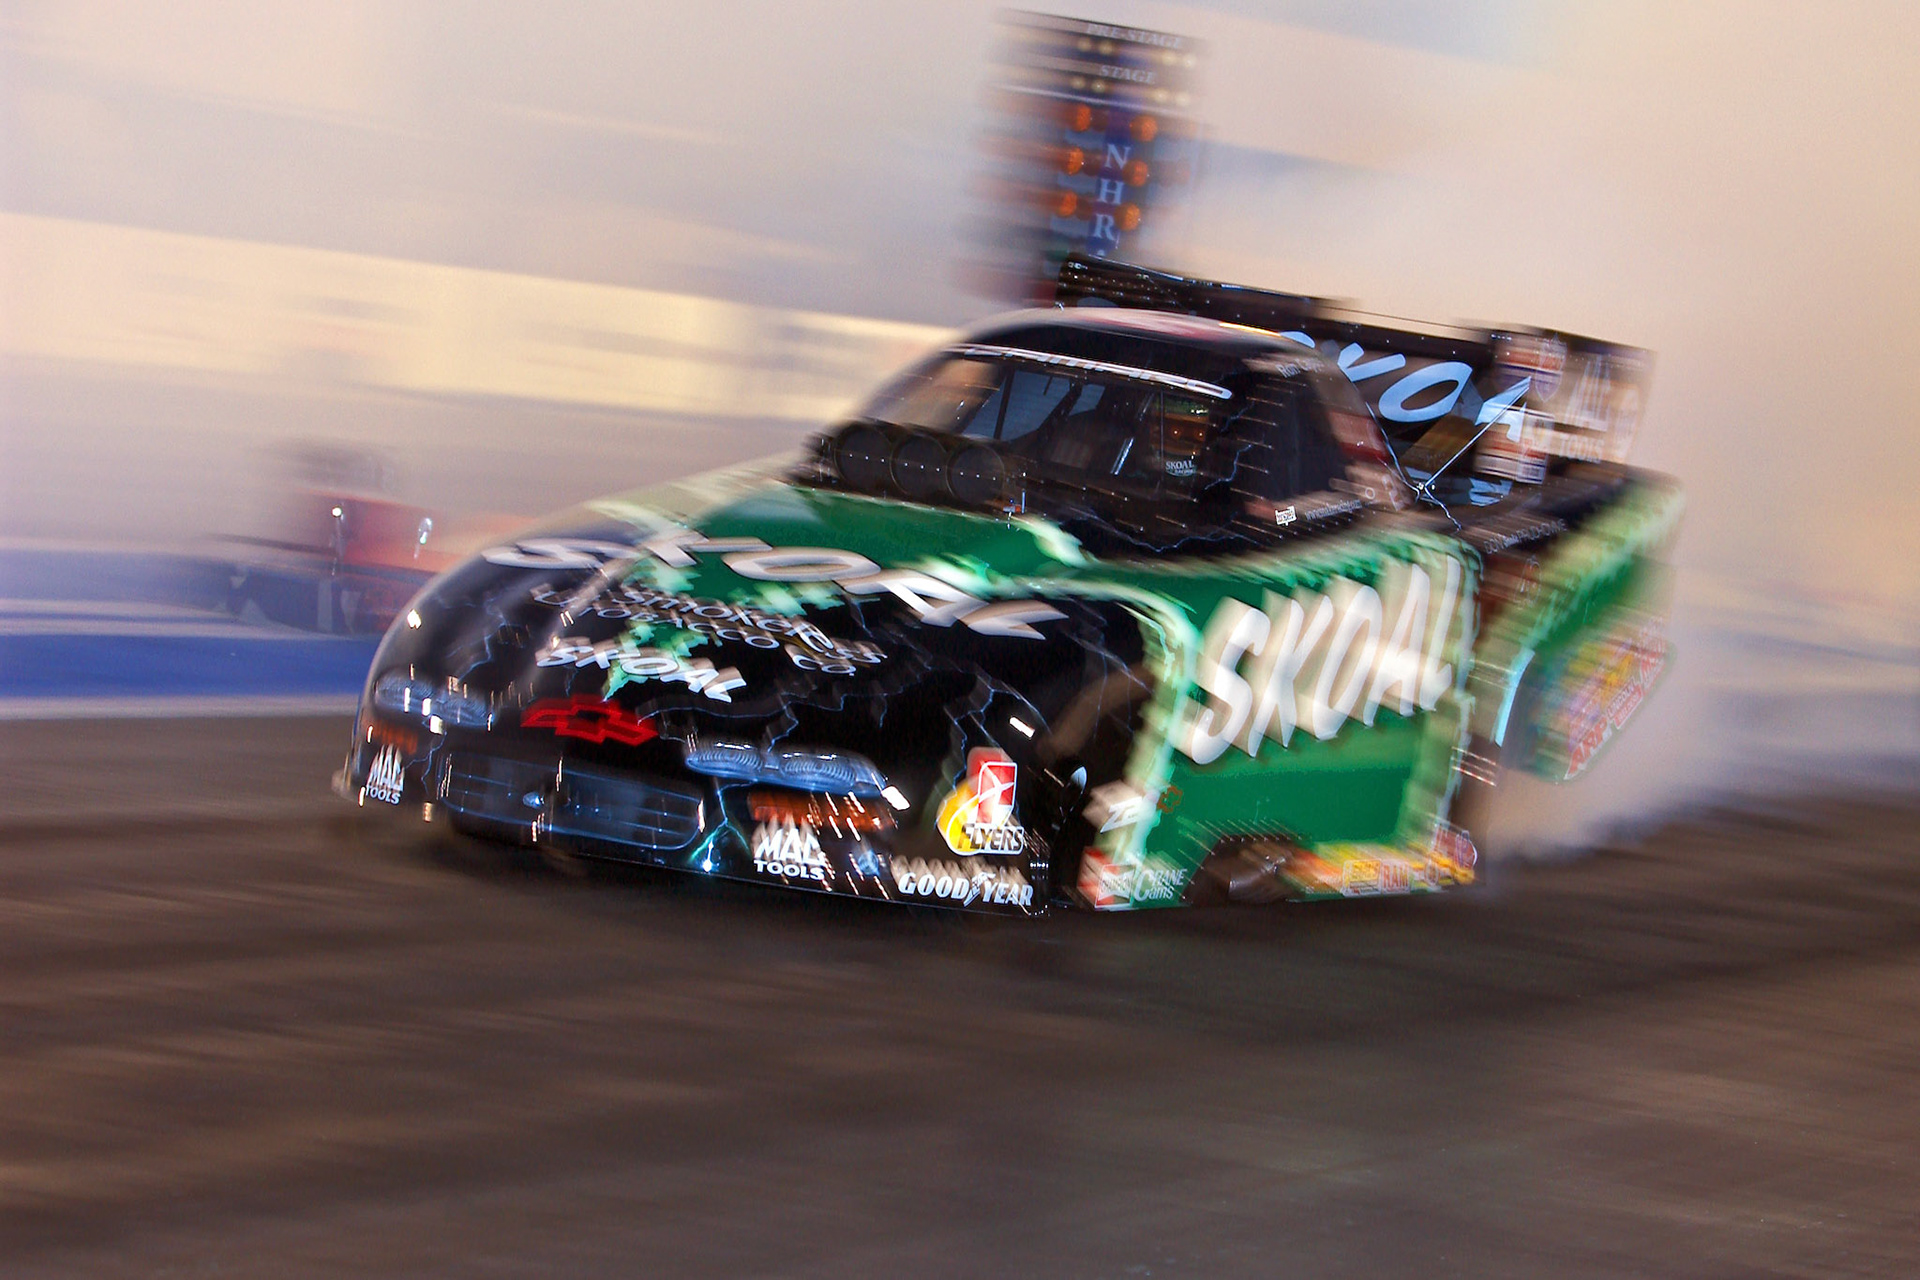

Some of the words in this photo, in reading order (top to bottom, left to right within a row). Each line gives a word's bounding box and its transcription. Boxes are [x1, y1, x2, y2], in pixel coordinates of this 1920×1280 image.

[1086, 23, 1183, 49] PRE-STAGE
[1100, 64, 1155, 84] STAGE
[1092, 143, 1131, 257] NHR
[1165, 460, 1195, 470] SKOAL
[1191, 553, 1461, 765] SKOAL
[535, 644, 748, 704] SKOAL
[366, 785, 401, 805] TOOLS
[961, 824, 1023, 851] FLYERS
[753, 859, 826, 881] TOOLS
